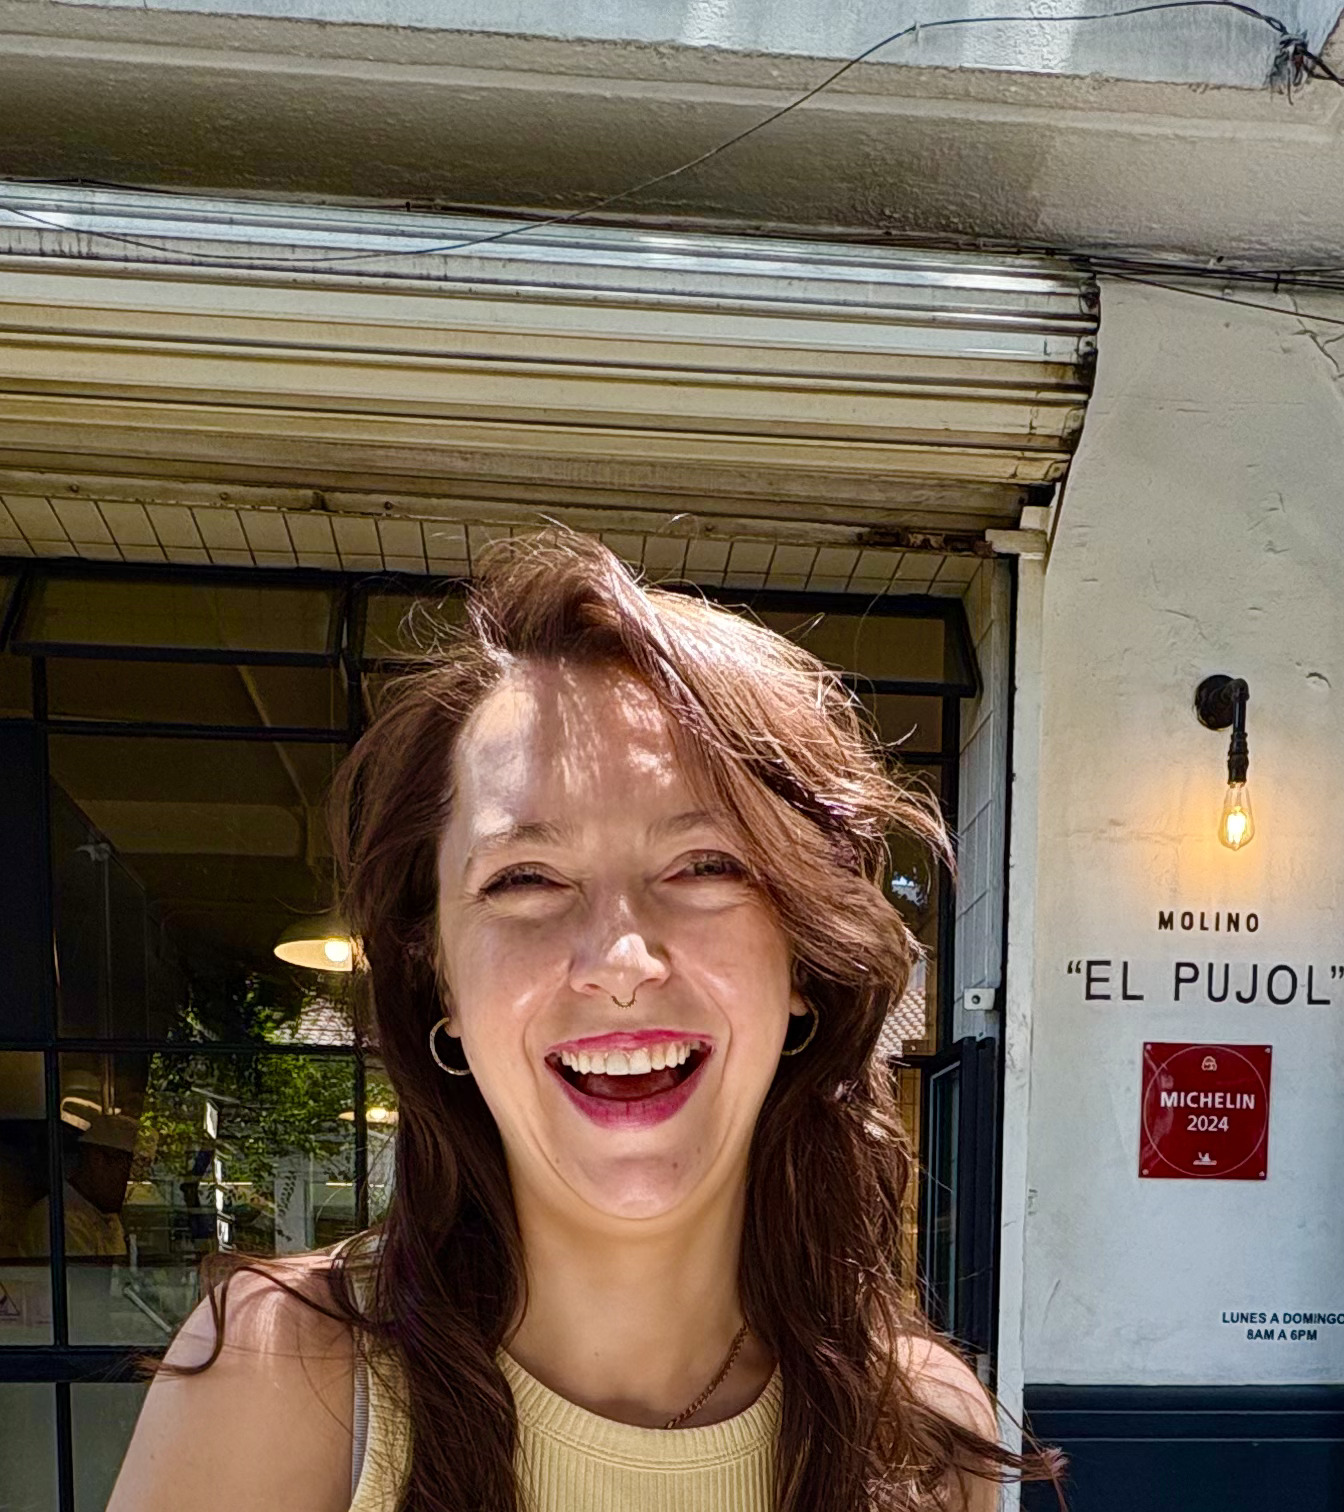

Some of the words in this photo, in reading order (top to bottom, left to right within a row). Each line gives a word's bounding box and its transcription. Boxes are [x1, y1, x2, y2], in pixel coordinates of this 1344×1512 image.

[1158, 910, 1260, 932] MOLINO
[1067, 960, 1144, 1001] “EL
[1173, 962, 1344, 1005] PUJOL”
[1160, 1091, 1255, 1109] MICHELIN
[1187, 1115, 1229, 1131] 2024
[1222, 1312, 1267, 1324] LUNES
[1270, 1313, 1280, 1324] A
[1246, 1329, 1274, 1340] 8AM
[1277, 1329, 1287, 1340] A
[1290, 1330, 1317, 1341] 6PM
